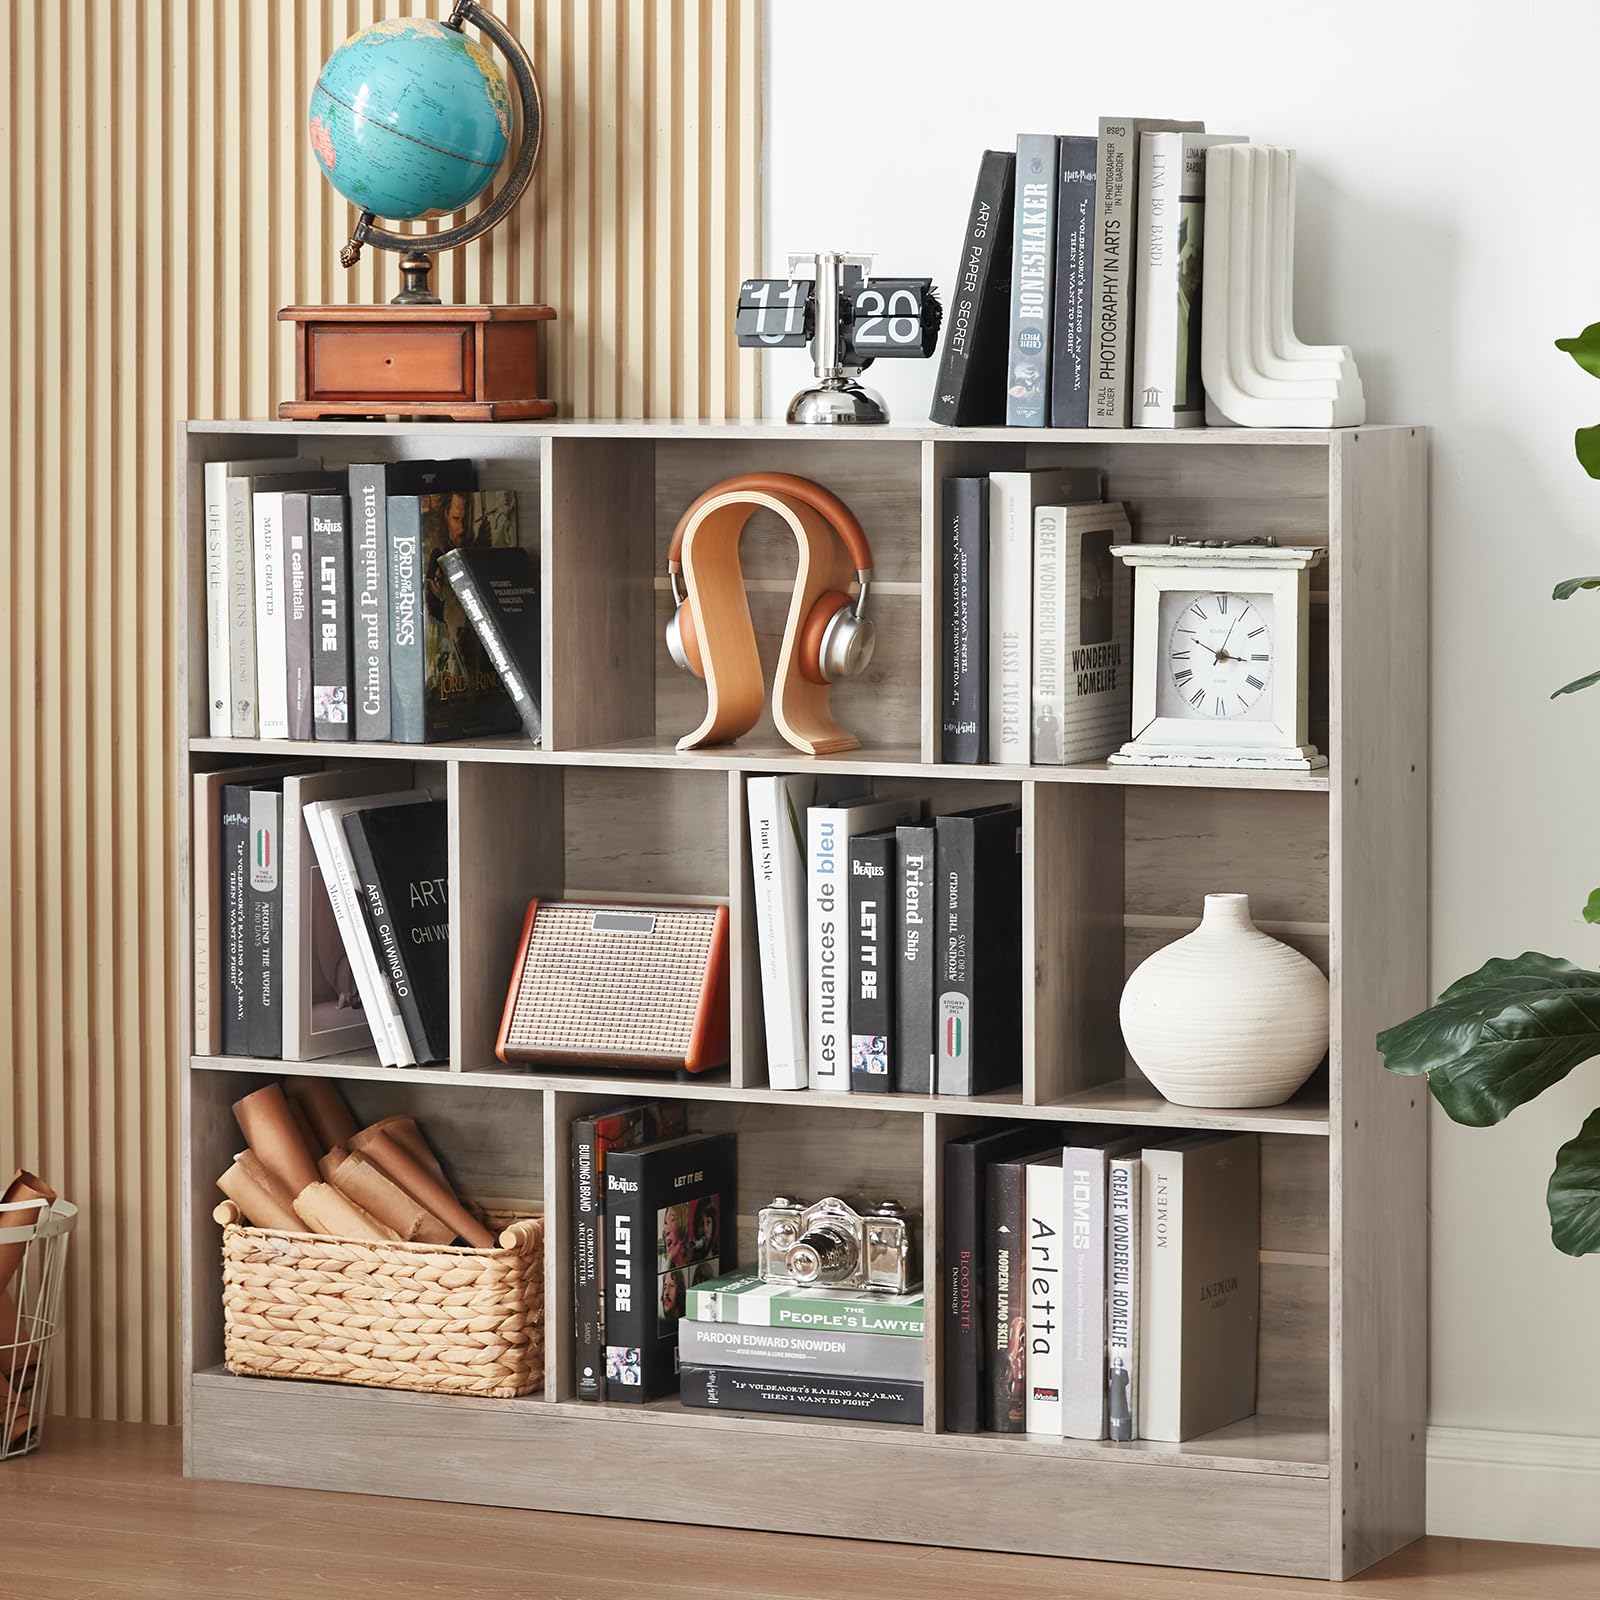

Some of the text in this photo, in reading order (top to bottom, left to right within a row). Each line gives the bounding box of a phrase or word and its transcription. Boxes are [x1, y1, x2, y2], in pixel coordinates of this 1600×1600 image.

[1107, 127, 1126, 137] Casa
[1186, 148, 1199, 159] LINA
[1105, 142, 1115, 200] PHOTOGRAPHER
[1114, 152, 1124, 207] IN THE GARDEN
[1150, 154, 1165, 267] LINA BO BARDI
[1019, 183, 1048, 319] BONESHAKER
[952, 201, 991, 355] ARTS PAPER SECRET
[1068, 275, 1076, 305] WANT
[1100, 219, 1120, 380] PHOTOGRAPHY IN ARTS
[1068, 307, 1074, 319] TO
[1075, 288, 1084, 333] RAISING
[1075, 336, 1082, 353] AN
[1097, 386, 1107, 416] IN FULL
[209, 504, 221, 589] LIFESTYLE
[233, 510, 244, 555] STORY
[263, 517, 272, 551] MADE
[235, 560, 245, 579] OF
[953, 552, 959, 570] AN
[236, 584, 247, 628] RUINS
[265, 565, 274, 616] CRAFTED
[320, 556, 337, 652] LET IT BE
[360, 485, 380, 715] Crime and Punishment
[393, 535, 416, 646] LORD RINGS
[952, 573, 960, 617] RAISING
[961, 586, 967, 597] TO
[1039, 516, 1056, 696] CREATE WONDERFUL HOMELIFE
[1072, 643, 1121, 672] WONDERFUL
[1002, 632, 1019, 744] SPECIAL ISSUE
[1077, 669, 1117, 696] HOMELIFE
[760, 819, 770, 849] Plant
[761, 853, 773, 881] Style
[328, 883, 344, 920] Monet
[905, 854, 923, 961] Friend Ship
[230, 942, 237, 954] TO
[366, 884, 409, 997] ARTS CHI WING LO
[411, 926, 433, 944] CHI
[948, 871, 958, 981] AROUND THE WORLD
[197, 911, 207, 1031] CREATIVITY
[261, 901, 270, 1007] AROUND THE WORLD
[816, 823, 836, 1077] Les nuances de bleu
[860, 901, 877, 999] LET IT BE
[958, 959, 965, 970] 80
[238, 968, 244, 985] AN
[958, 972, 965, 981] IN
[579, 1144, 591, 1212] BUILDING BRAND
[674, 1171, 704, 1188] LET IT BE
[1073, 1170, 1090, 1249] HOMES
[1157, 1174, 1168, 1248] MOMENT
[578, 1221, 586, 1287] ARCHITECTURE
[586, 1228, 594, 1280] CORPORATE
[615, 1215, 631, 1312] LET IT BE
[1112, 1168, 1129, 1348] CREATE WONDERFUL HOMELIFE
[997, 1249, 1009, 1350] MODERN LAMO SKILL
[1031, 1218, 1058, 1354] Arletta
[779, 1310, 858, 1327] PEOPLE'S
[843, 1306, 865, 1314] THE
[583, 1322, 591, 1344] SANDU
[697, 1331, 846, 1353] PARDON EDWARD SNOWDEN
[811, 1389, 851, 1397] RAISING
[871, 1393, 904, 1401] ARMY,
